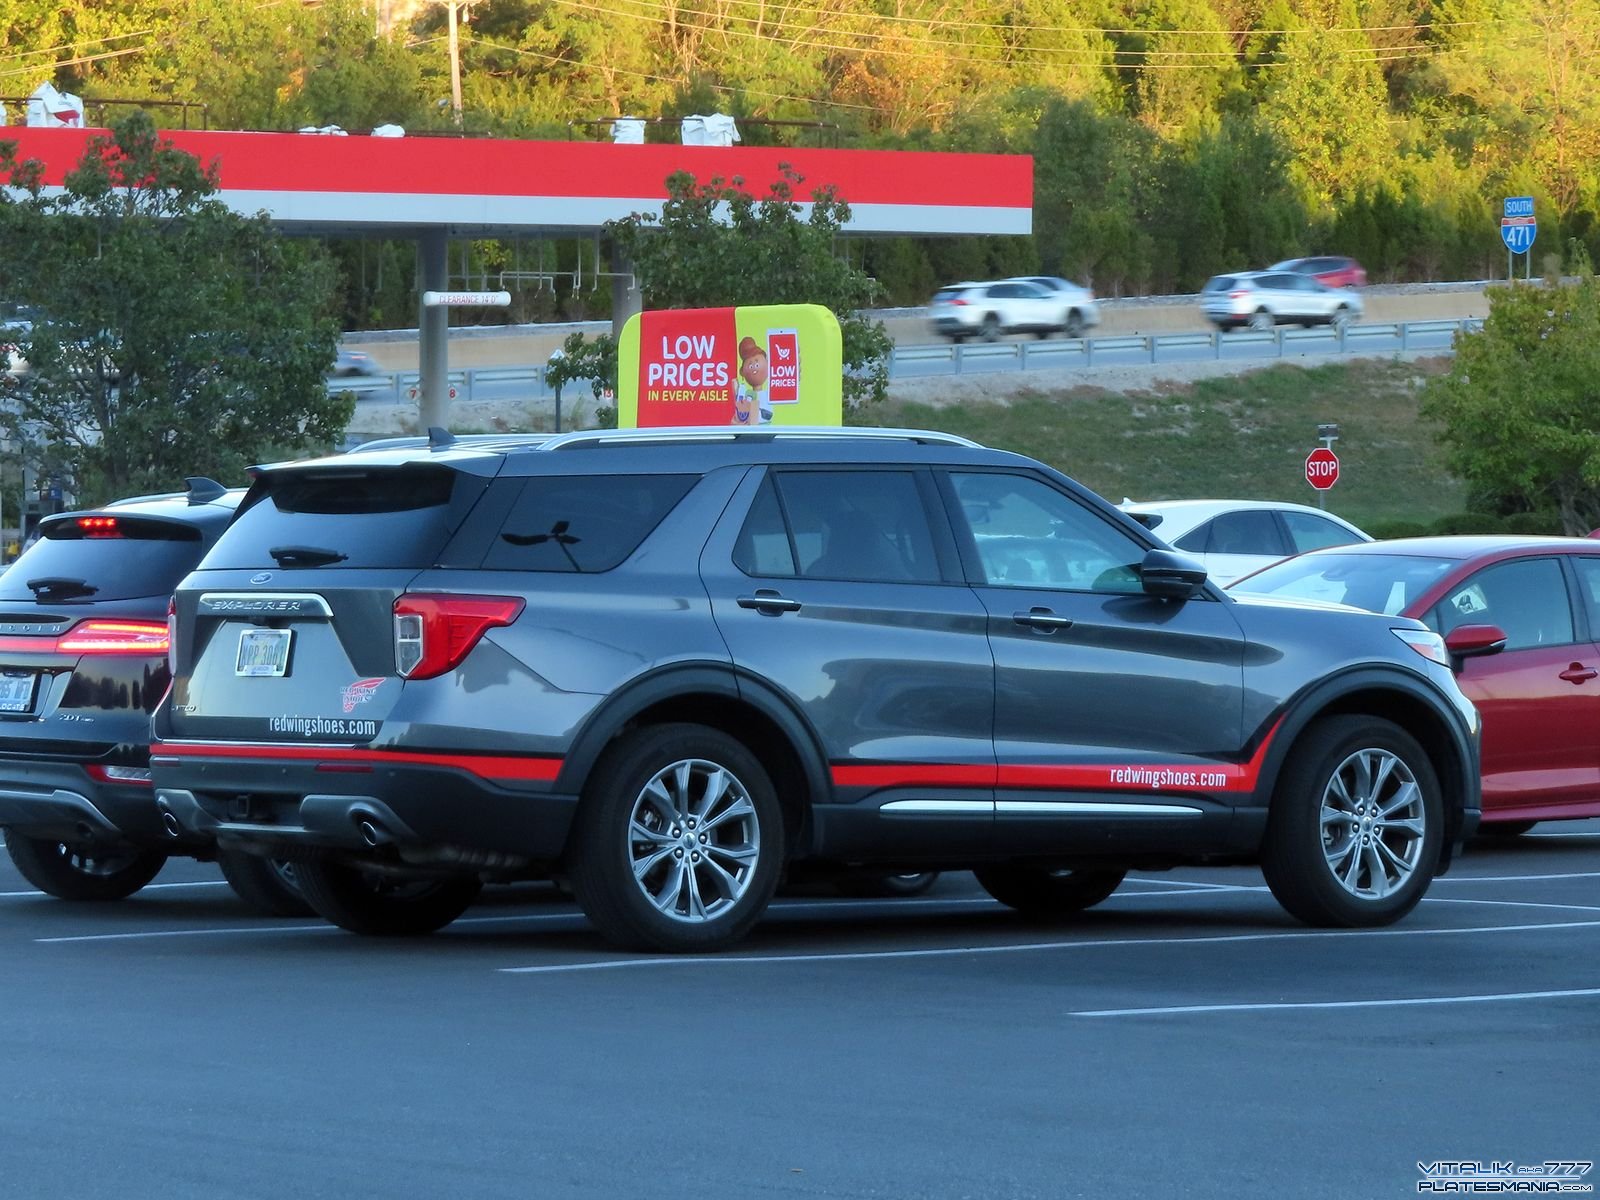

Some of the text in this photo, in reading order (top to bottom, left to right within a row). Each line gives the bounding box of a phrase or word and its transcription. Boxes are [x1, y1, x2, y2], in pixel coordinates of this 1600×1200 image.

[1507, 200, 1532, 213] SOUTH
[1507, 226, 1529, 246] 471
[439, 294, 479, 304] CLEARANCE
[663, 335, 715, 359] LOW
[648, 362, 729, 387] PRICES
[771, 365, 796, 377] LOW
[771, 378, 796, 387] PRICES
[410, 389, 417, 399] 7
[449, 388, 456, 399] 8
[648, 389, 729, 401] IN EVERY AISLE
[1307, 461, 1336, 477] STOP
[212, 600, 300, 610] EXPLORER
[269, 714, 376, 737] redwingshoes.com
[1110, 767, 1226, 788] redwingshoes.com
